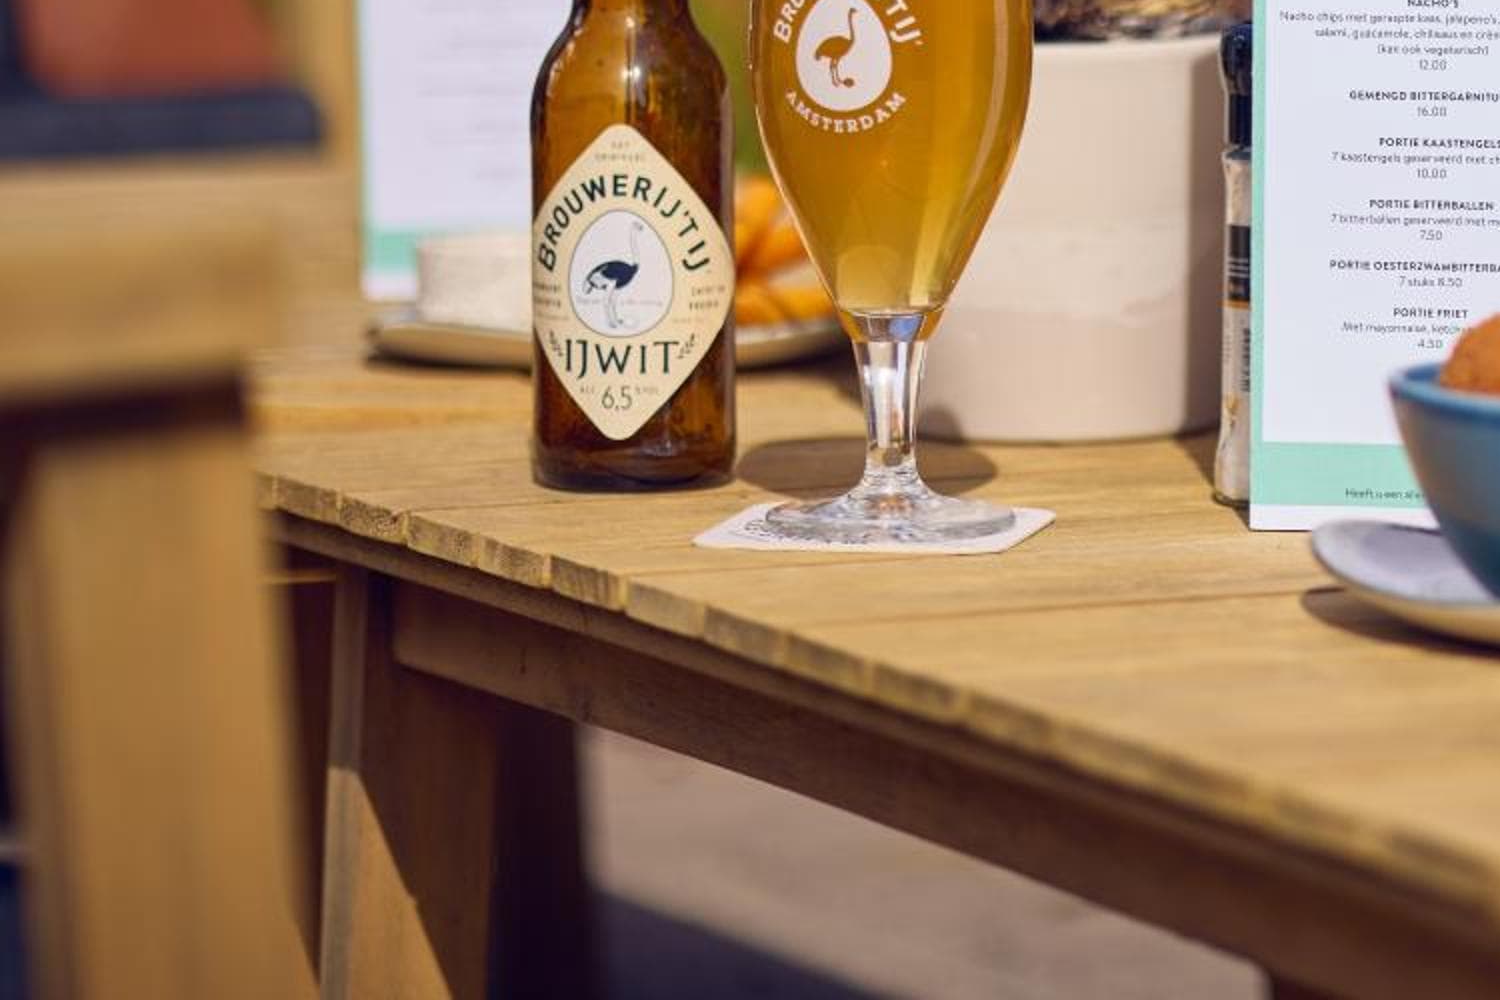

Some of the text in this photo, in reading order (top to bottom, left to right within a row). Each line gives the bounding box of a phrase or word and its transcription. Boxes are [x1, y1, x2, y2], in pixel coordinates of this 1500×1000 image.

[1345, 12, 1367, 21] met
[1349, 90, 1407, 101] GEMENGD
[785, 88, 907, 133] AMSTERDAM
[1379, 137, 1420, 148] PORTIE
[1369, 199, 1494, 211] PORTIE BITTERBALLEN
[1329, 259, 1371, 271] PORTIE
[1393, 307, 1469, 319] PORTIE FRIET
[566, 338, 680, 380] IJWIT
